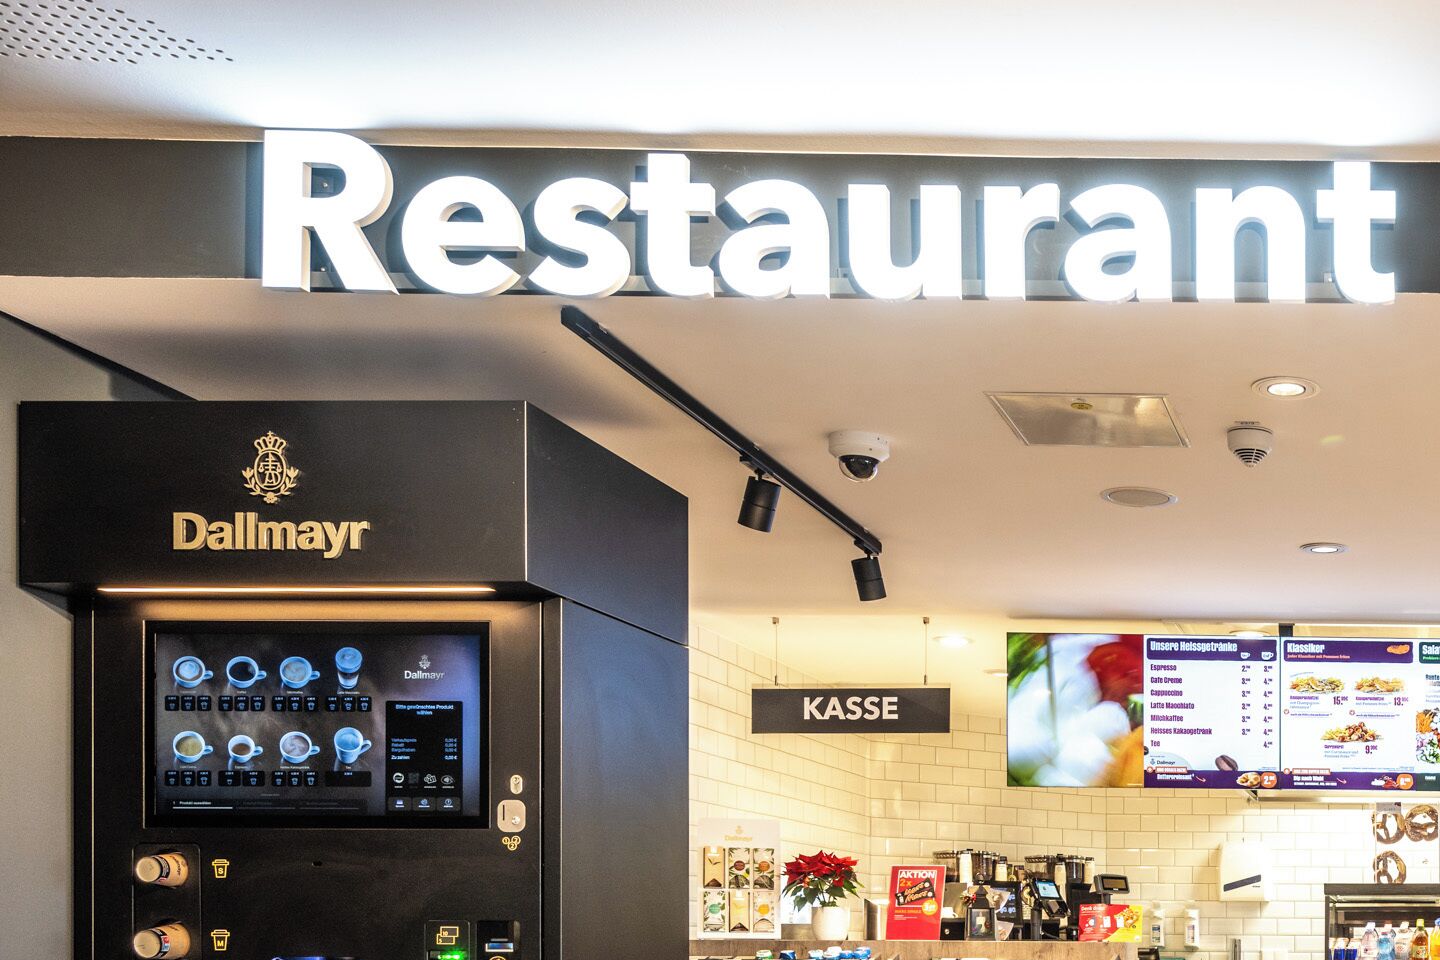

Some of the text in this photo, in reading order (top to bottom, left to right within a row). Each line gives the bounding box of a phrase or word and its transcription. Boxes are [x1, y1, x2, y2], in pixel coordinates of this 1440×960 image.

[262, 128, 1396, 304] Restaurant
[173, 512, 370, 559] Dallmayr
[1150, 640, 1237, 652] Unsere Heissgetränke
[1287, 643, 1325, 653] Klassiker
[1150, 664, 1177, 672] Espresso
[404, 670, 444, 680] Dallmayr
[1150, 689, 1183, 697] Cappuccino
[803, 696, 899, 720] KASSE
